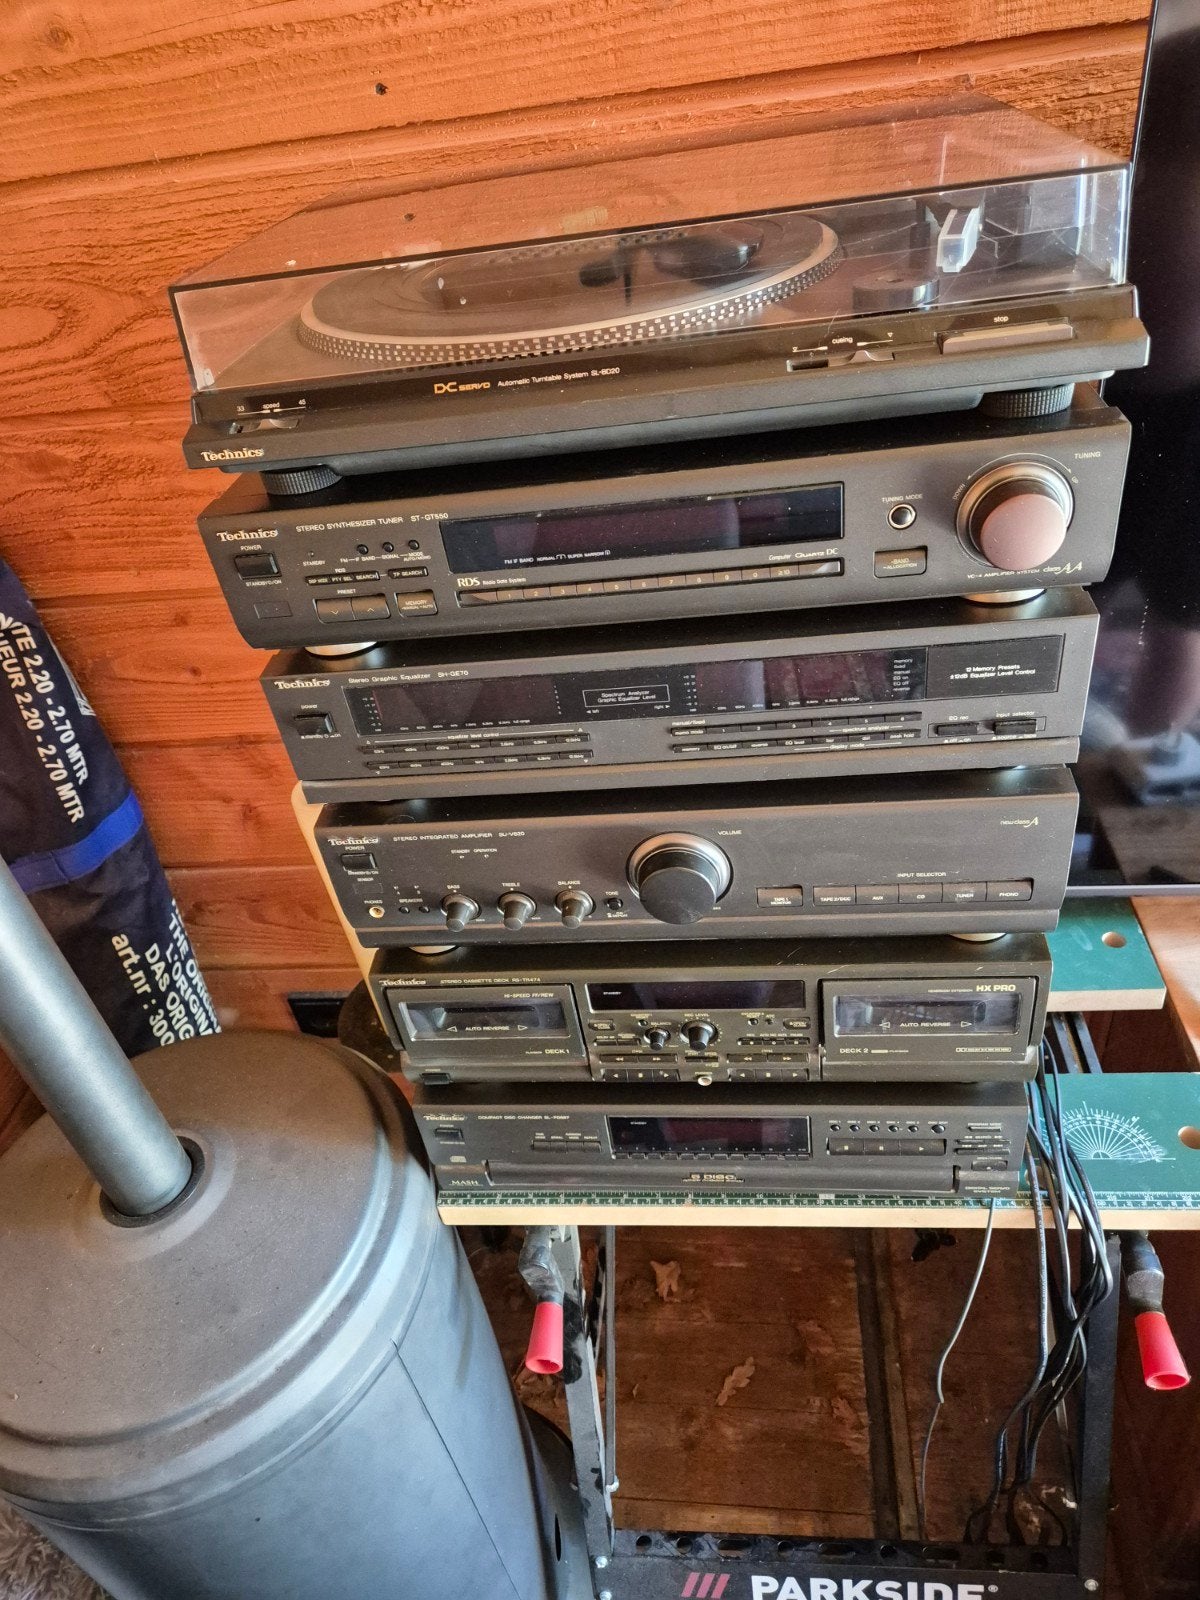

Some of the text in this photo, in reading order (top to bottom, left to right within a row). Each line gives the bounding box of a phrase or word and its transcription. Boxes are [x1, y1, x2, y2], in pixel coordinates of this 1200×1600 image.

[993, 315, 1008, 323] stop
[832, 336, 853, 346] cueing
[498, 378, 530, 388] Automatic
[532, 374, 562, 384] Turntable
[563, 371, 589, 382] System
[433, 382, 457, 395] DC
[262, 402, 280, 411] speed
[200, 447, 264, 462] Technics
[1074, 451, 1101, 463] TUNING
[882, 496, 905, 504] TUNING
[295, 524, 325, 535] STEREO
[326, 518, 377, 530] SYNTHESIZER
[378, 516, 404, 525] TUNER
[216, 529, 279, 542] Technics
[240, 543, 263, 552] POWER
[826, 547, 839, 557] DC
[402, 569, 423, 577] SEARCH
[456, 576, 481, 589] RDS
[337, 588, 357, 596] PRESET
[970, 670, 996, 678] Equalizer
[1015, 667, 1036, 675] Control
[973, 665, 995, 673] Memory
[997, 663, 1021, 671] Presets
[348, 677, 370, 685] Stereo
[371, 675, 399, 684] Graphic
[400, 672, 431, 682] Equalizer
[274, 677, 331, 691] Technics
[23, 654, 54, 694] 2.20
[47, 705, 76, 744] 2.70
[65, 742, 89, 785] MTR
[14, 691, 45, 731] 2.20
[37, 743, 69, 783] 2.70
[55, 782, 85, 824] MTR
[328, 837, 380, 847] Technics
[419, 833, 459, 841] INTEGRATED
[169, 912, 189, 961] THE
[145, 942, 170, 992] DAS
[379, 978, 427, 986] Technics
[975, 984, 992, 993] HX
[993, 983, 1017, 993] PRO
[483, 1024, 511, 1032] REVERSE
[920, 1020, 951, 1028] REVERSE
[423, 1114, 469, 1122] Technics
